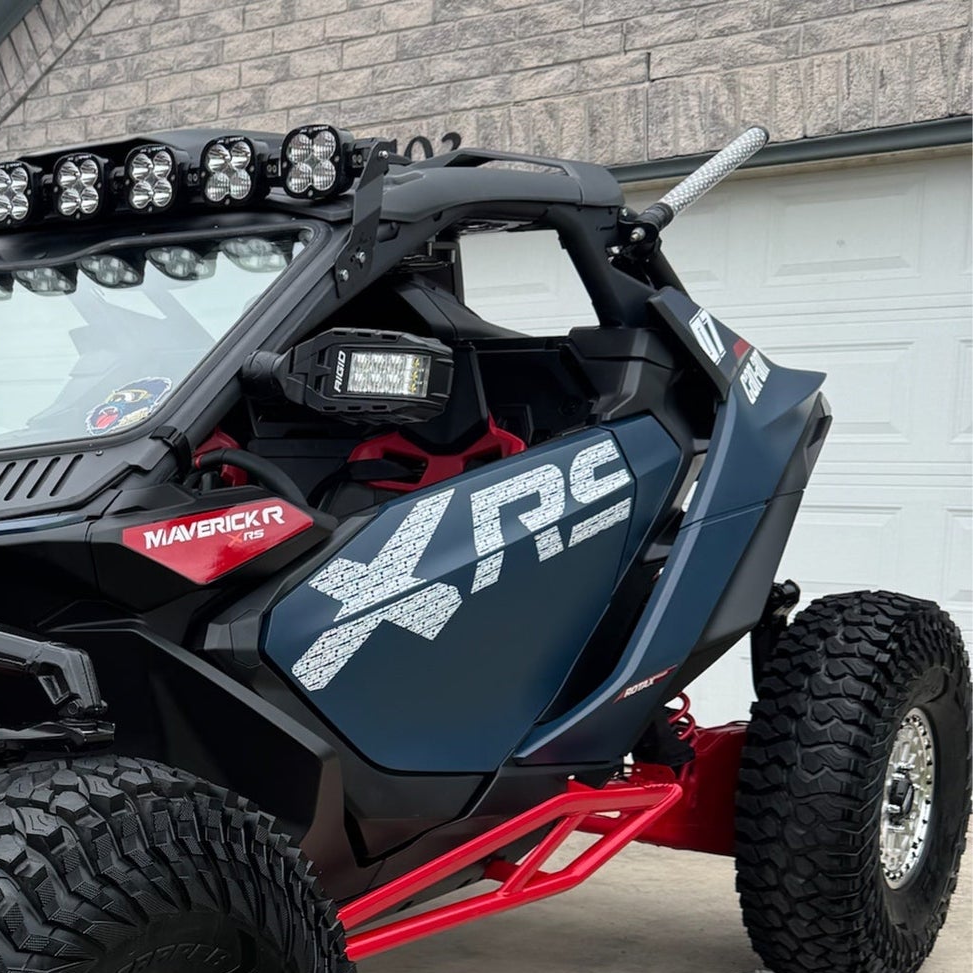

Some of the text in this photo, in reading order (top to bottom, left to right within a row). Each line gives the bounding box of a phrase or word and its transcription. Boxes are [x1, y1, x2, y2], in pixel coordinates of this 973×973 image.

[333, 350, 347, 393] RIGID
[143, 505, 285, 549] MAVERICK R
[291, 438, 632, 692] XRS
